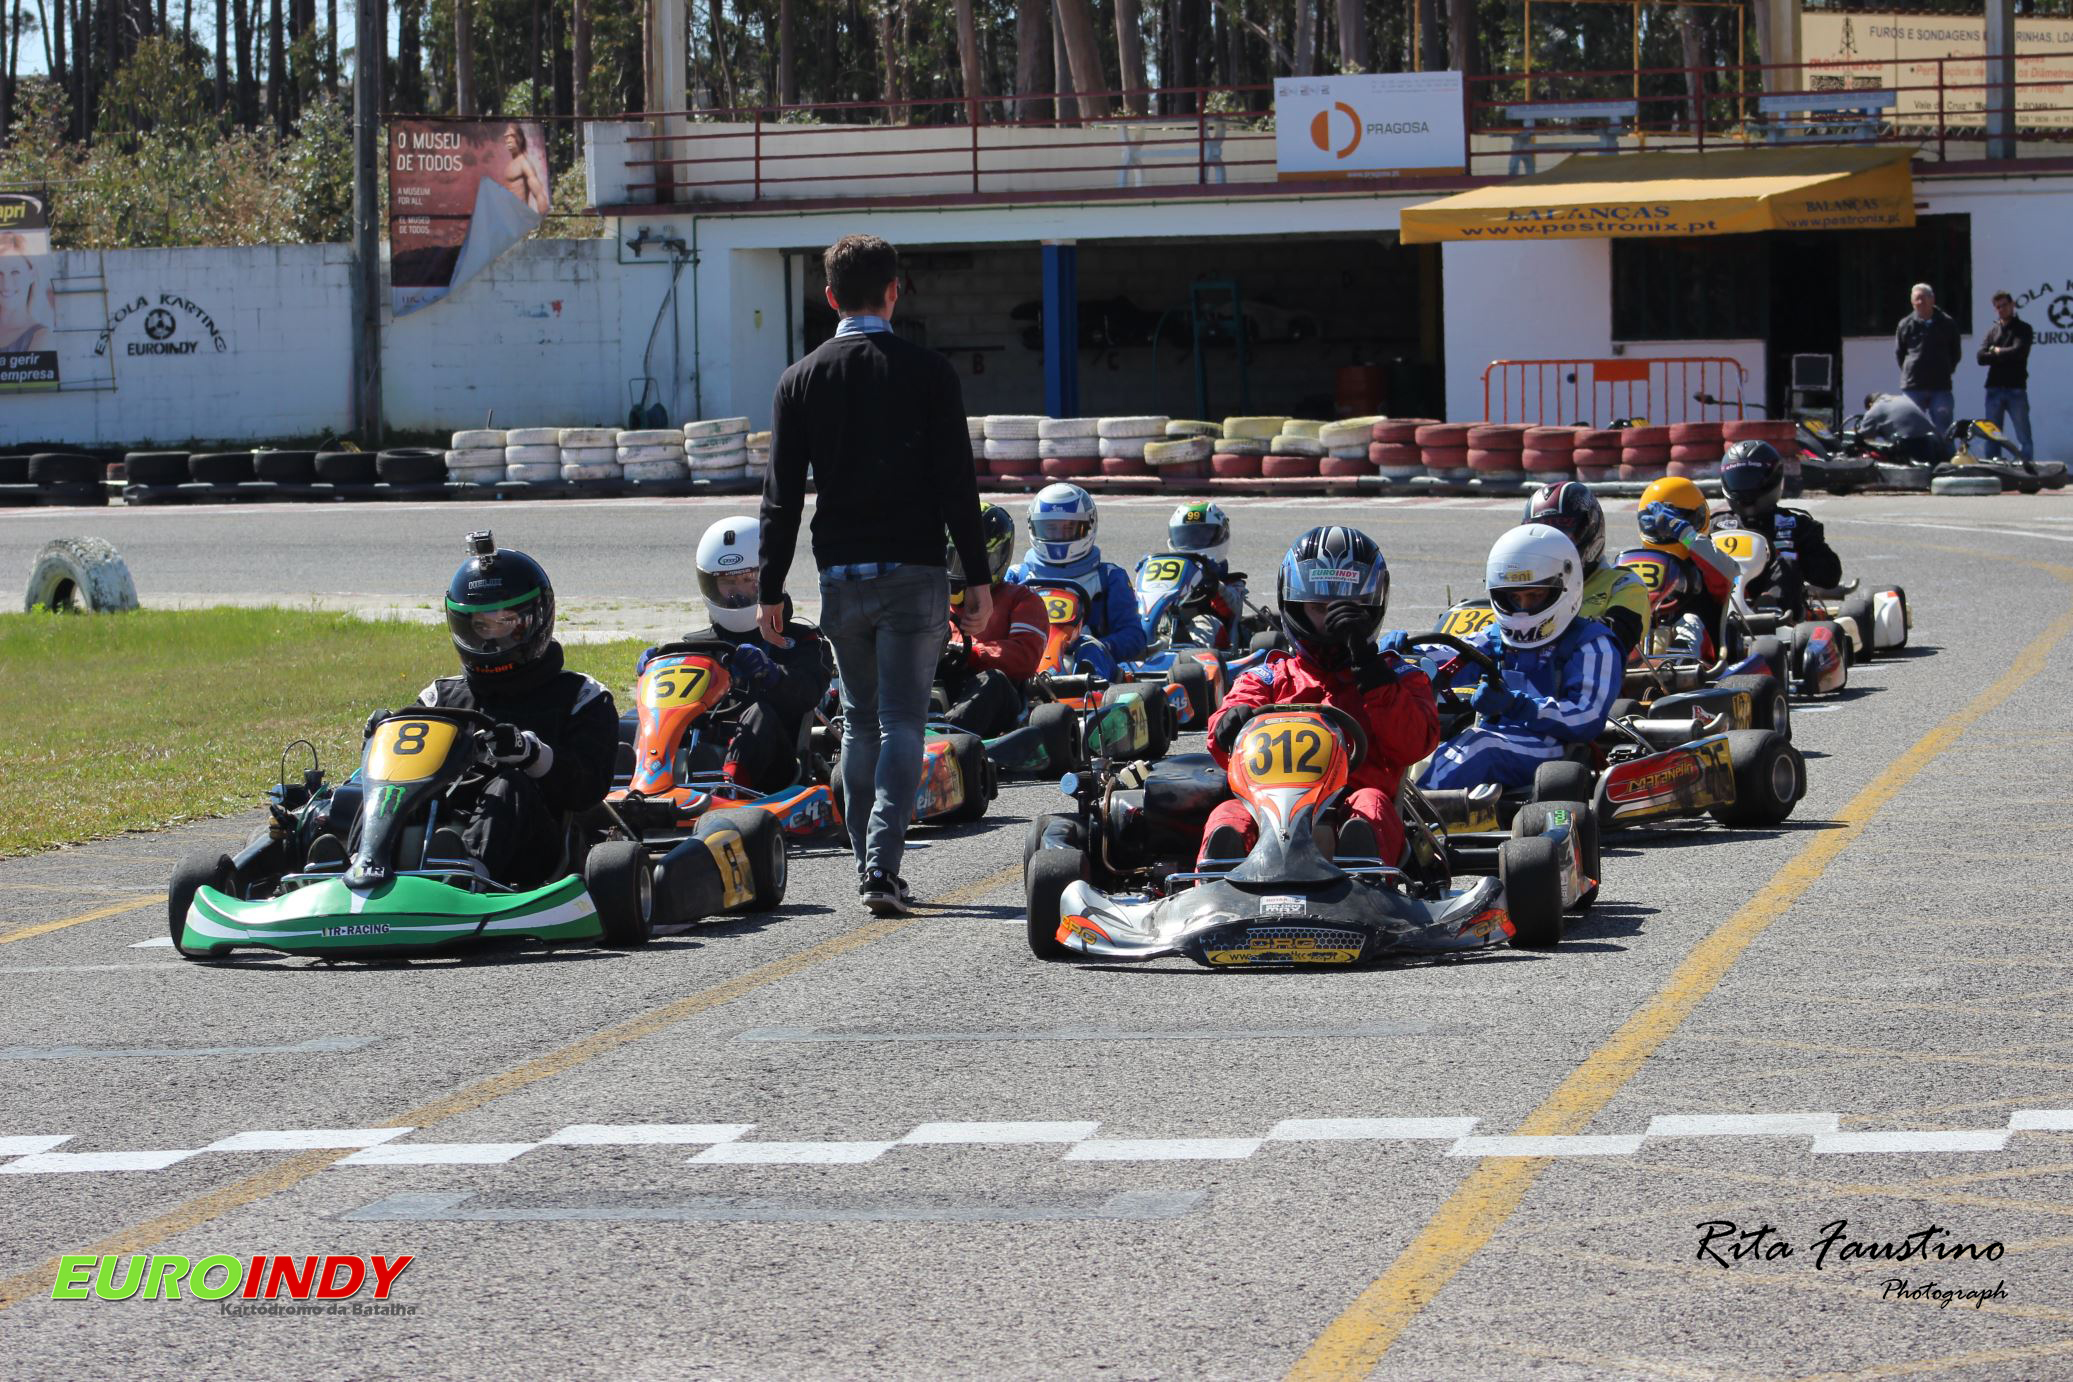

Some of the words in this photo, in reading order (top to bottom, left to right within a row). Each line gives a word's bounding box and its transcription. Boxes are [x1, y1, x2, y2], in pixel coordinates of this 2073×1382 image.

[1870, 26, 1904, 39] FUROS
[1907, 28, 1914, 39] E
[1917, 29, 1980, 41] SONDAGENS
[1366, 121, 1430, 135] PRAGOSA
[398, 132, 407, 149] O
[413, 132, 461, 150] MUSEU
[397, 154, 414, 171] DE
[417, 154, 463, 172] TODOS
[1462, 219, 1718, 237] www.pestronix.pt
[160, 294, 227, 353] KARTING
[127, 341, 198, 356] EUROINDY
[9, 353, 40, 369] gerir
[1, 369, 55, 383] empresa
[1187, 511, 1201, 520] 99
[1146, 561, 1181, 581] 99
[1311, 569, 1358, 578] EUROINDY
[393, 722, 429, 755] 8
[1248, 729, 1323, 776] 312
[722, 843, 743, 893] 8
[1250, 937, 1317, 950] CRG
